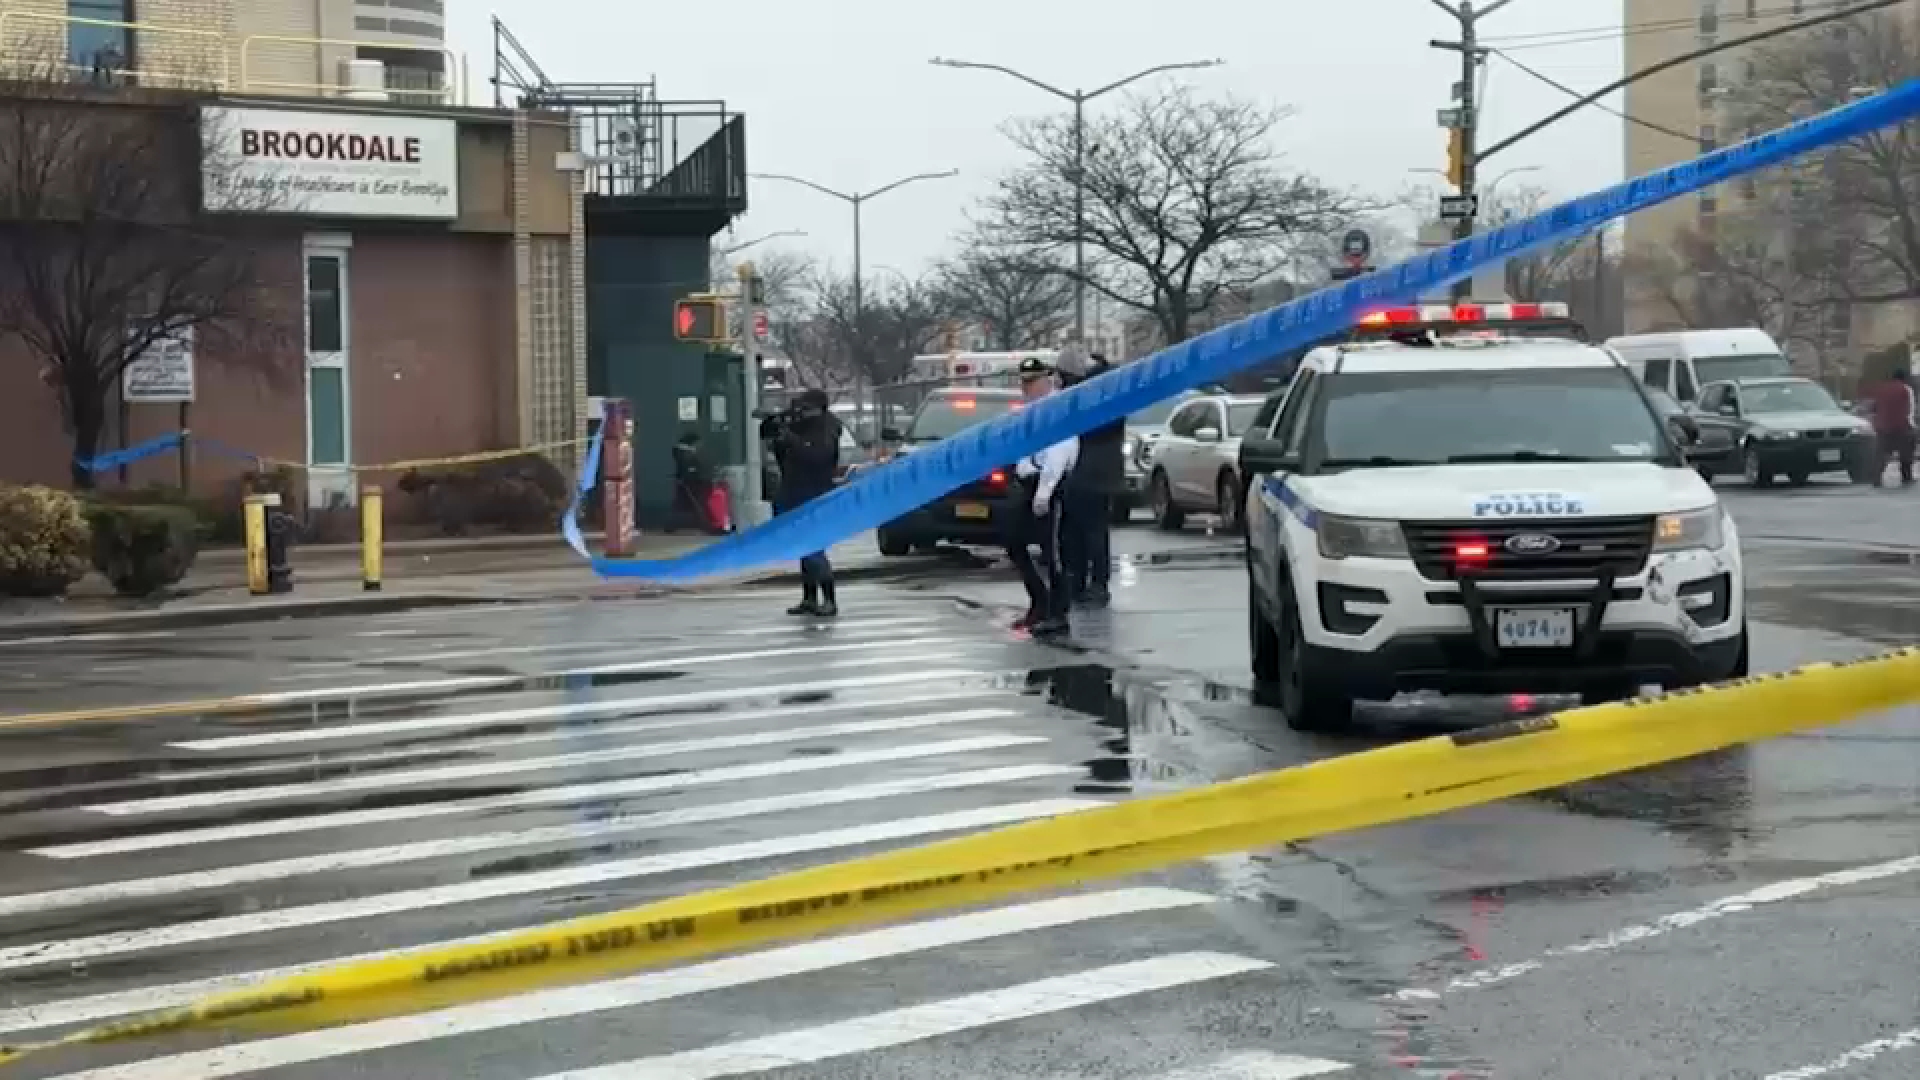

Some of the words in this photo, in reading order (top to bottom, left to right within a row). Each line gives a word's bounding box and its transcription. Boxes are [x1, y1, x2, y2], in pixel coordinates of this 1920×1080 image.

[241, 128, 421, 163] BROOKDALE
[1474, 501, 1584, 517] POLICE
[1503, 619, 1549, 638] 4074
